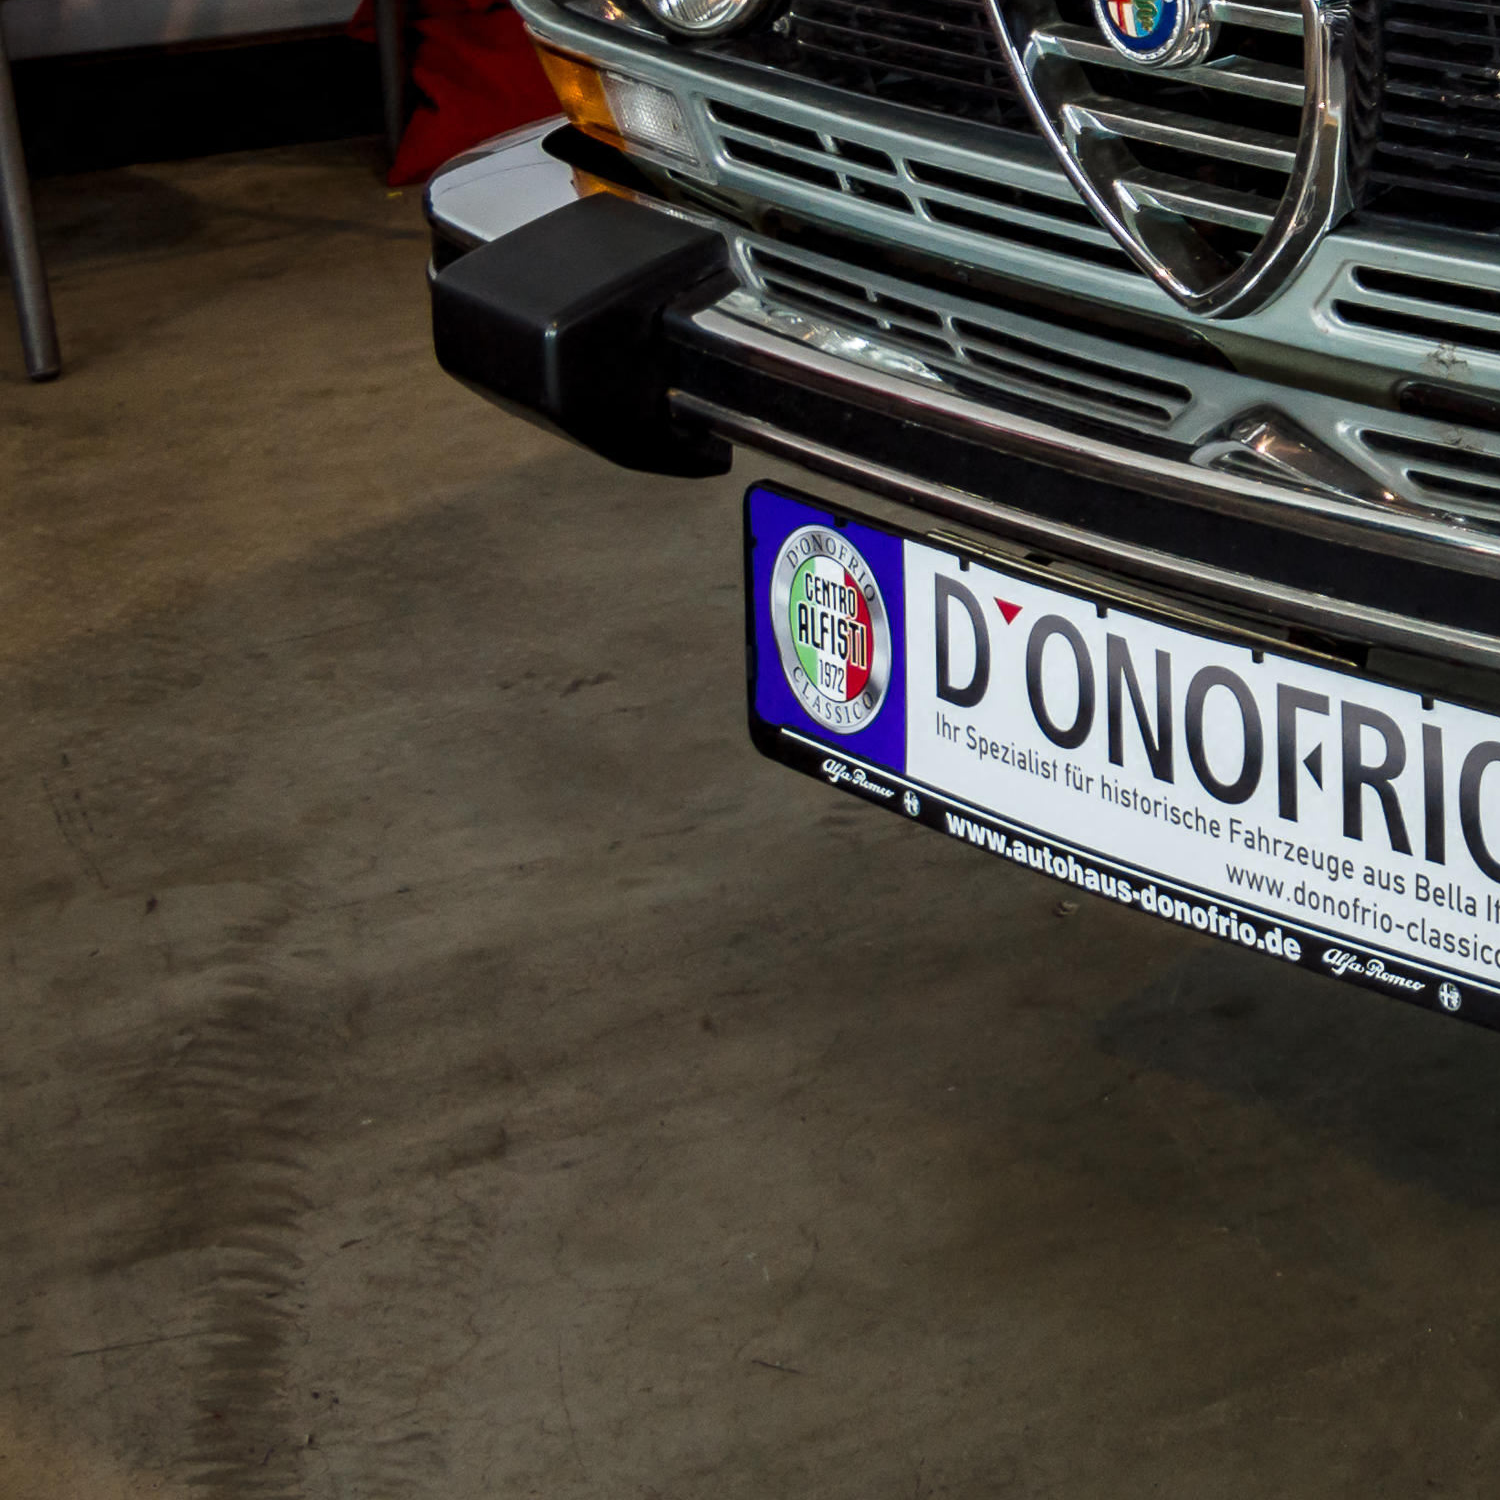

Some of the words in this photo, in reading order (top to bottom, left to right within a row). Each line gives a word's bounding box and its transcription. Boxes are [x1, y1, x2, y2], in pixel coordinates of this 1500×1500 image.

[786, 534, 876, 603] D'ONOFRIO
[804, 572, 857, 618] CENTRO
[798, 602, 867, 669] ALFISTI
[792, 666, 875, 725] CLASSICO
[819, 659, 845, 694] 1972
[821, 757, 853, 784] Alfa
[852, 768, 896, 799] Romeo
[935, 711, 961, 743] Ihr
[966, 725, 1058, 783] Spezialist
[1065, 762, 1094, 797] für
[1100, 776, 1221, 839] historische
[1229, 817, 1355, 882] Fahrzeuge
[1363, 864, 1406, 895] aus
[1415, 873, 1477, 917] Bella
[945, 811, 1302, 962] www.autohaus-donofrio.de
[1322, 947, 1365, 976] Alfa
[1365, 958, 1426, 993] Romeo
